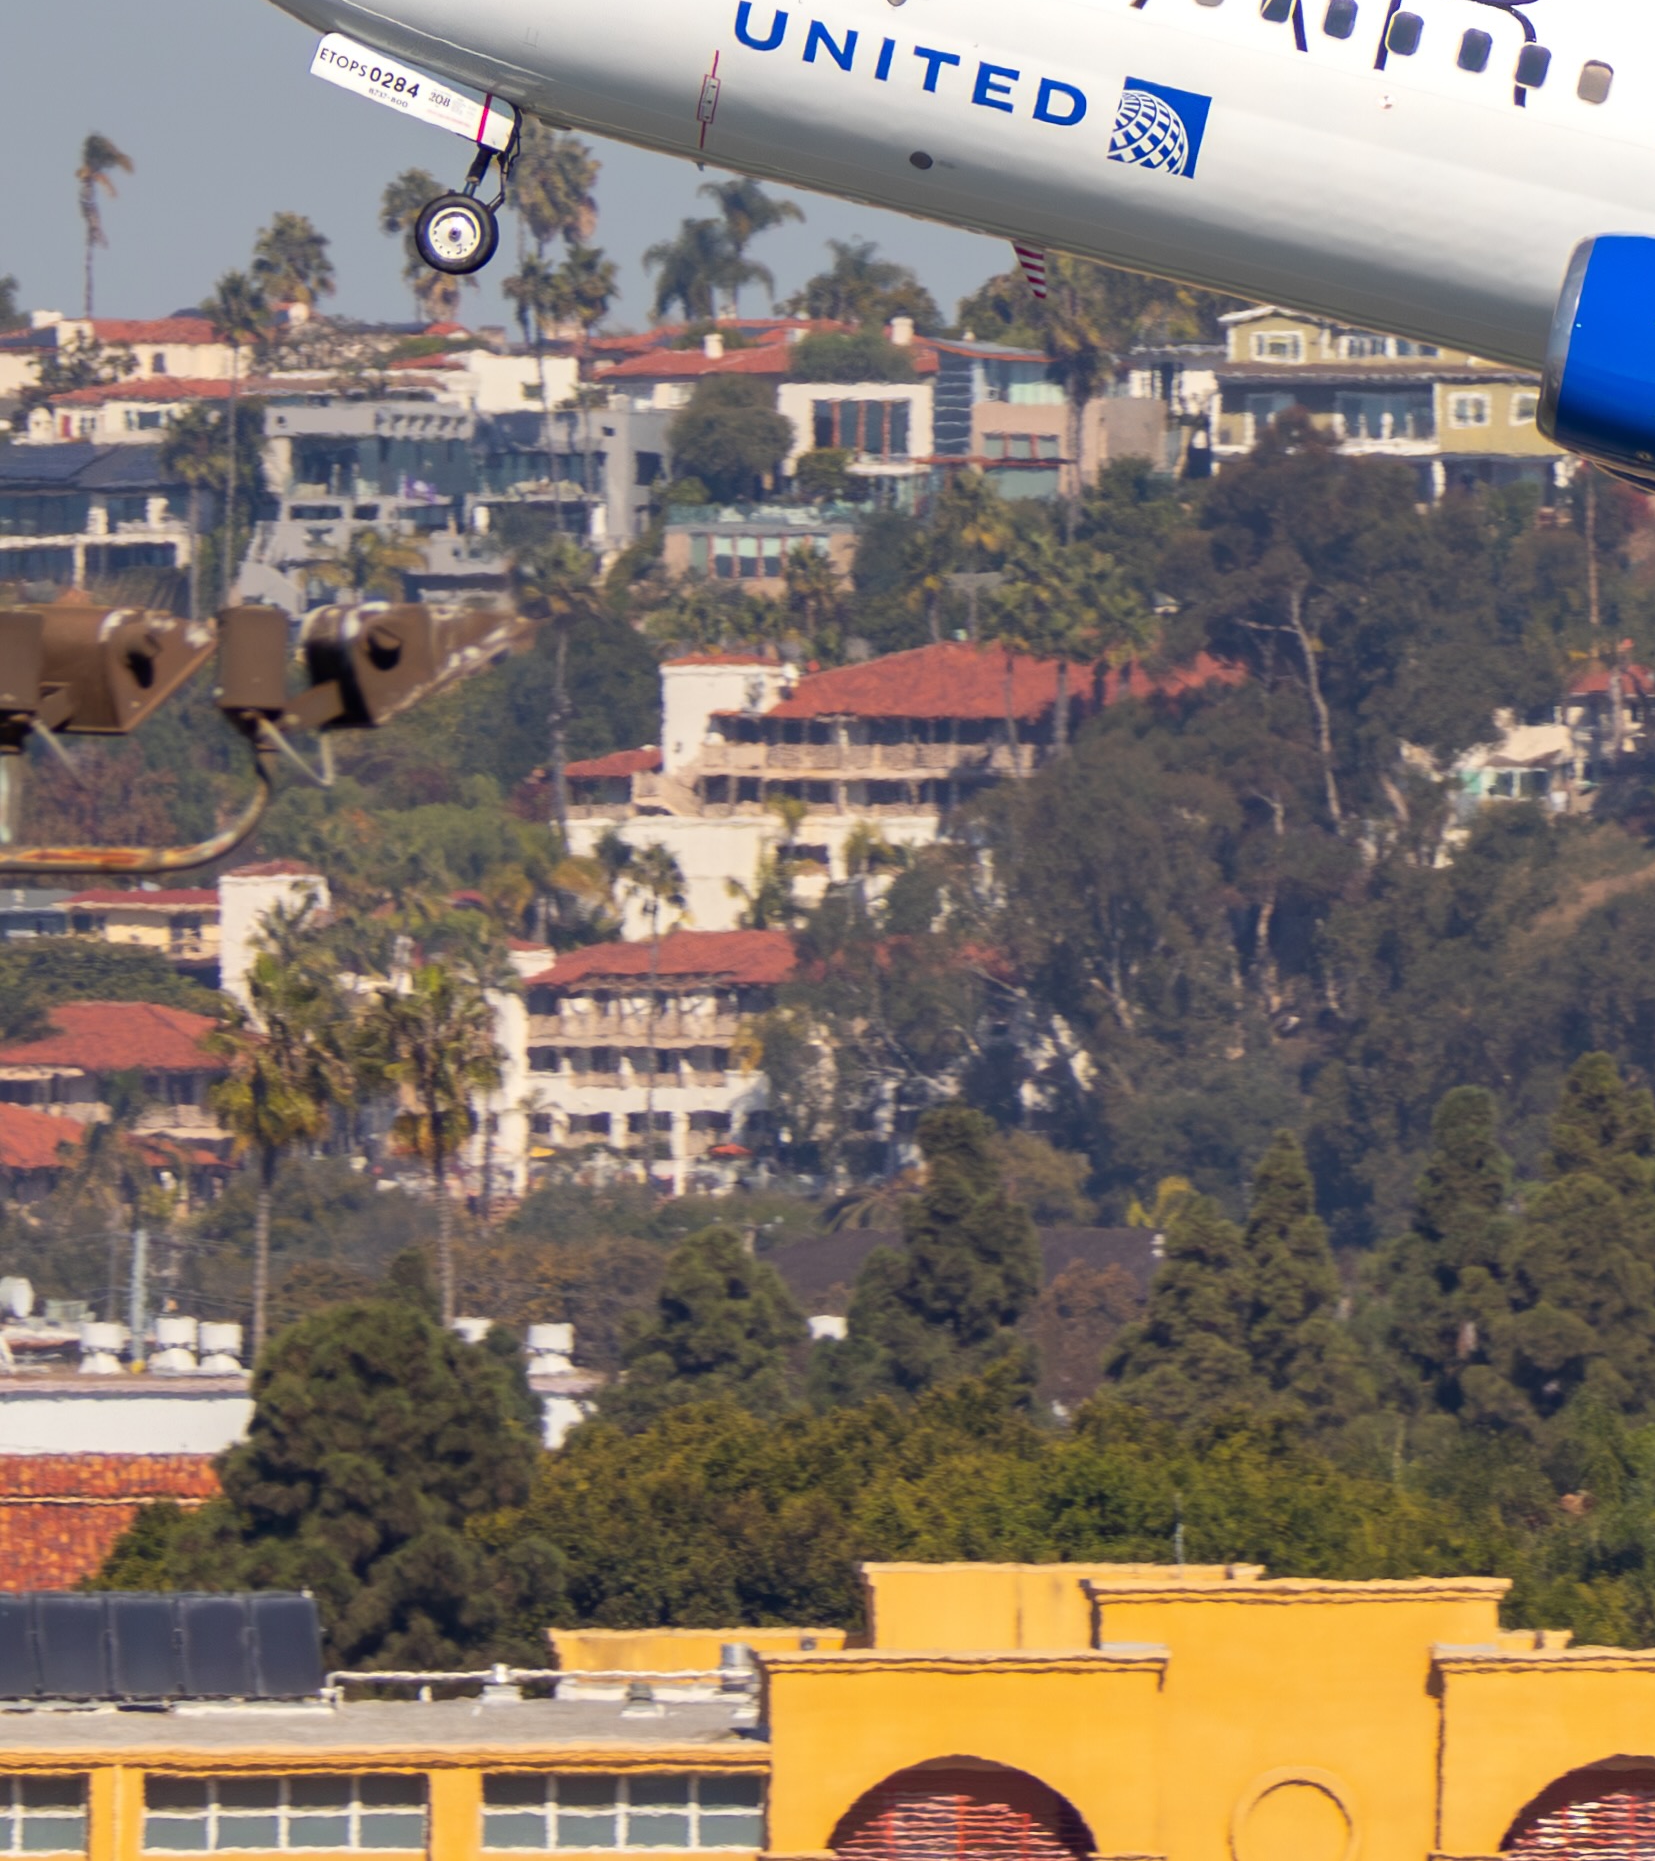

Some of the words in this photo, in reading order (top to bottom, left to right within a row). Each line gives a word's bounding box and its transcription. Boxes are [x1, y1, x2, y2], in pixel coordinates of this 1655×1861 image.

[319, 47, 368, 77] ETOPS
[369, 67, 420, 98] 0284
[735, 1, 1087, 126] UNITED
